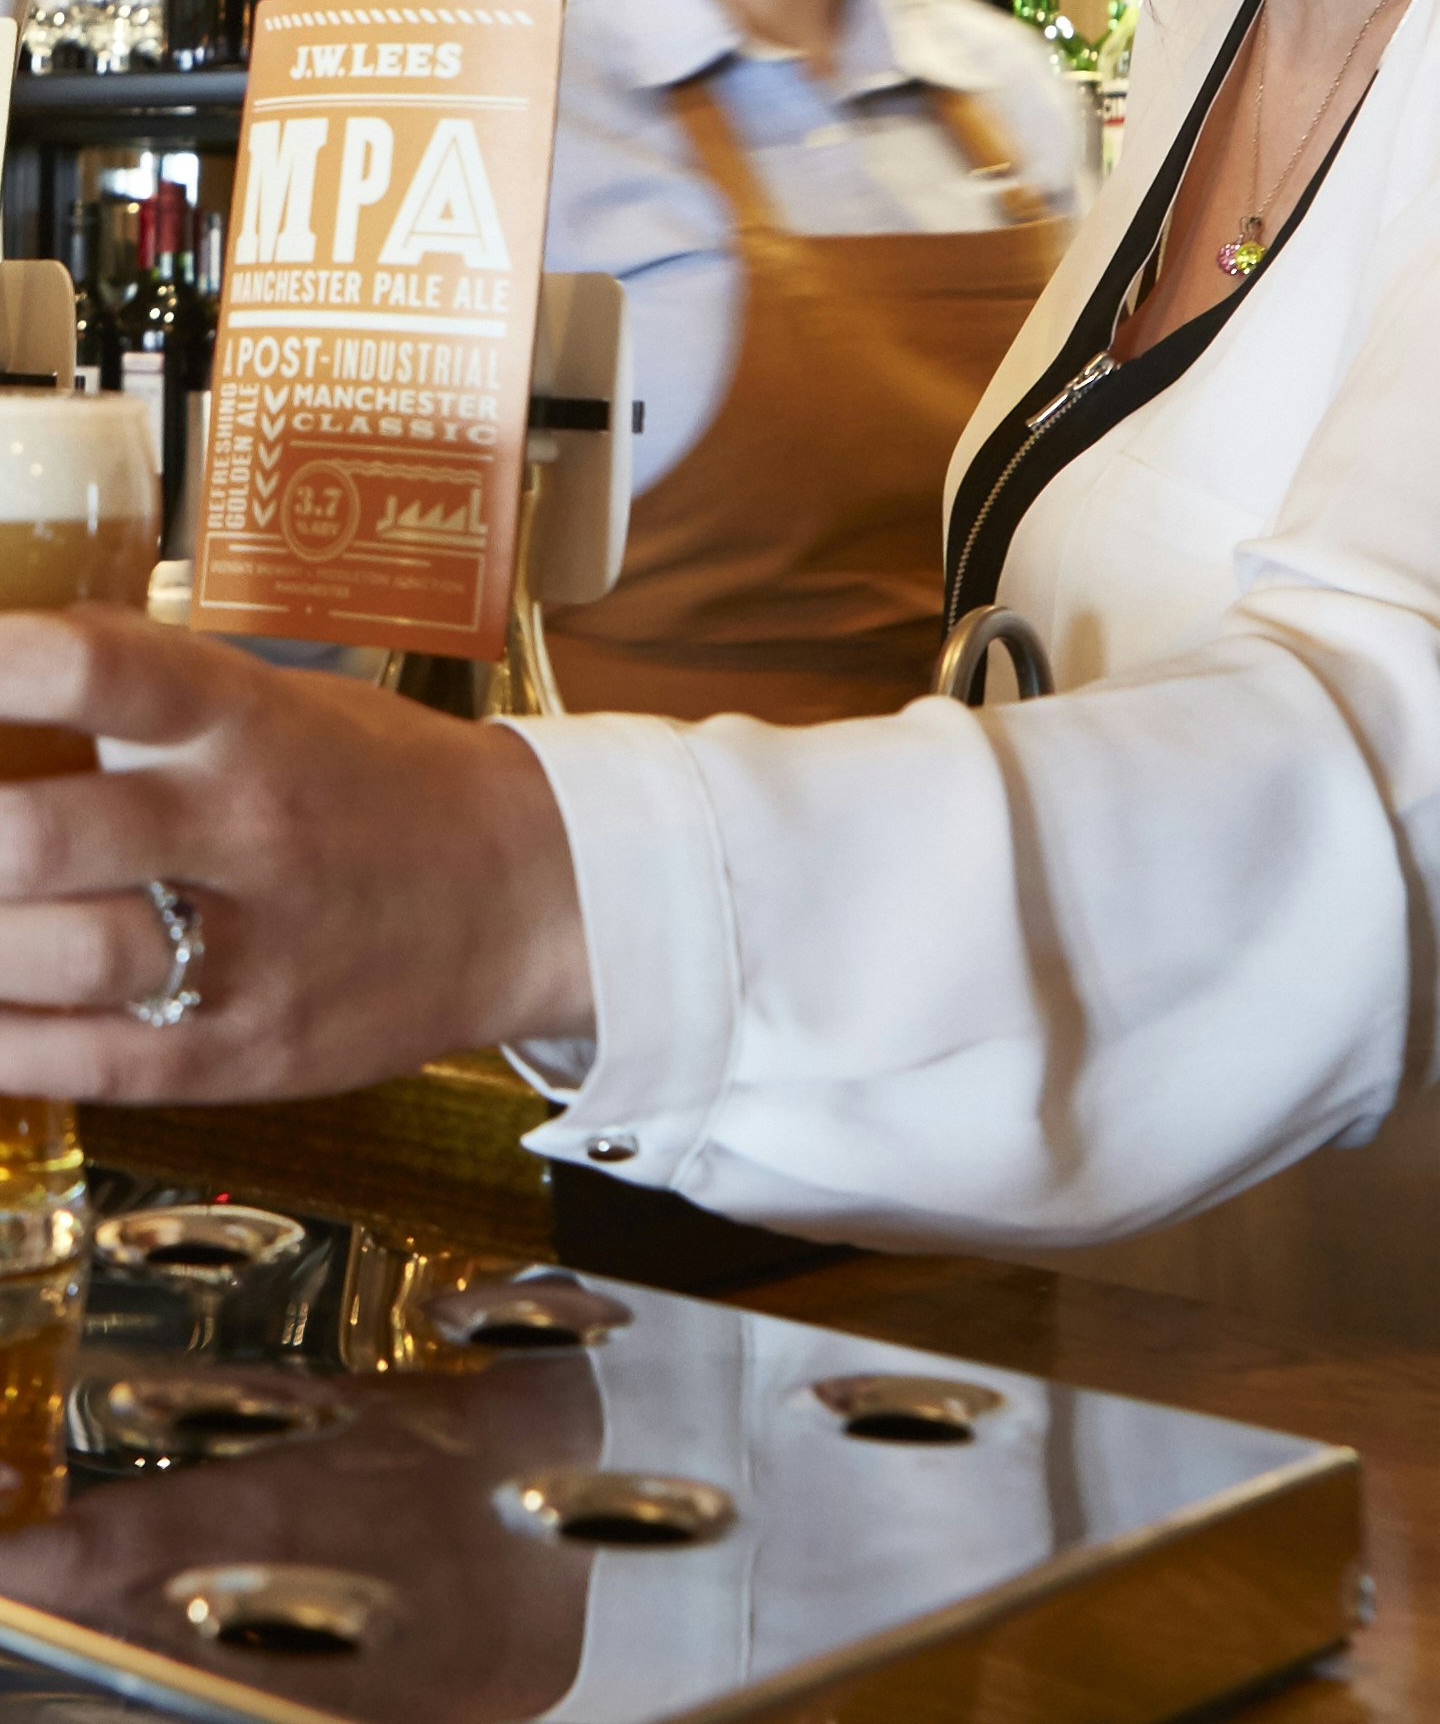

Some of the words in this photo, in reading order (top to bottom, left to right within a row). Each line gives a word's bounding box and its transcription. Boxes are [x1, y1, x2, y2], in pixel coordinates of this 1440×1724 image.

[234, 116, 513, 272] MPA
[230, 269, 362, 305] MANCHESTER
[373, 271, 444, 309] PALE
[452, 275, 512, 314] ALE
[222, 338, 233, 376] A
[236, 335, 502, 390] POST-INDUSTRIAL
[237, 382, 260, 427] ALE
[292, 383, 498, 421] MANCHESTER
[292, 412, 498, 446] CLASSIC
[207, 382, 238, 530] REFRESHING
[225, 435, 254, 530] GOLDEN
[295, 485, 344, 518] 3.7
